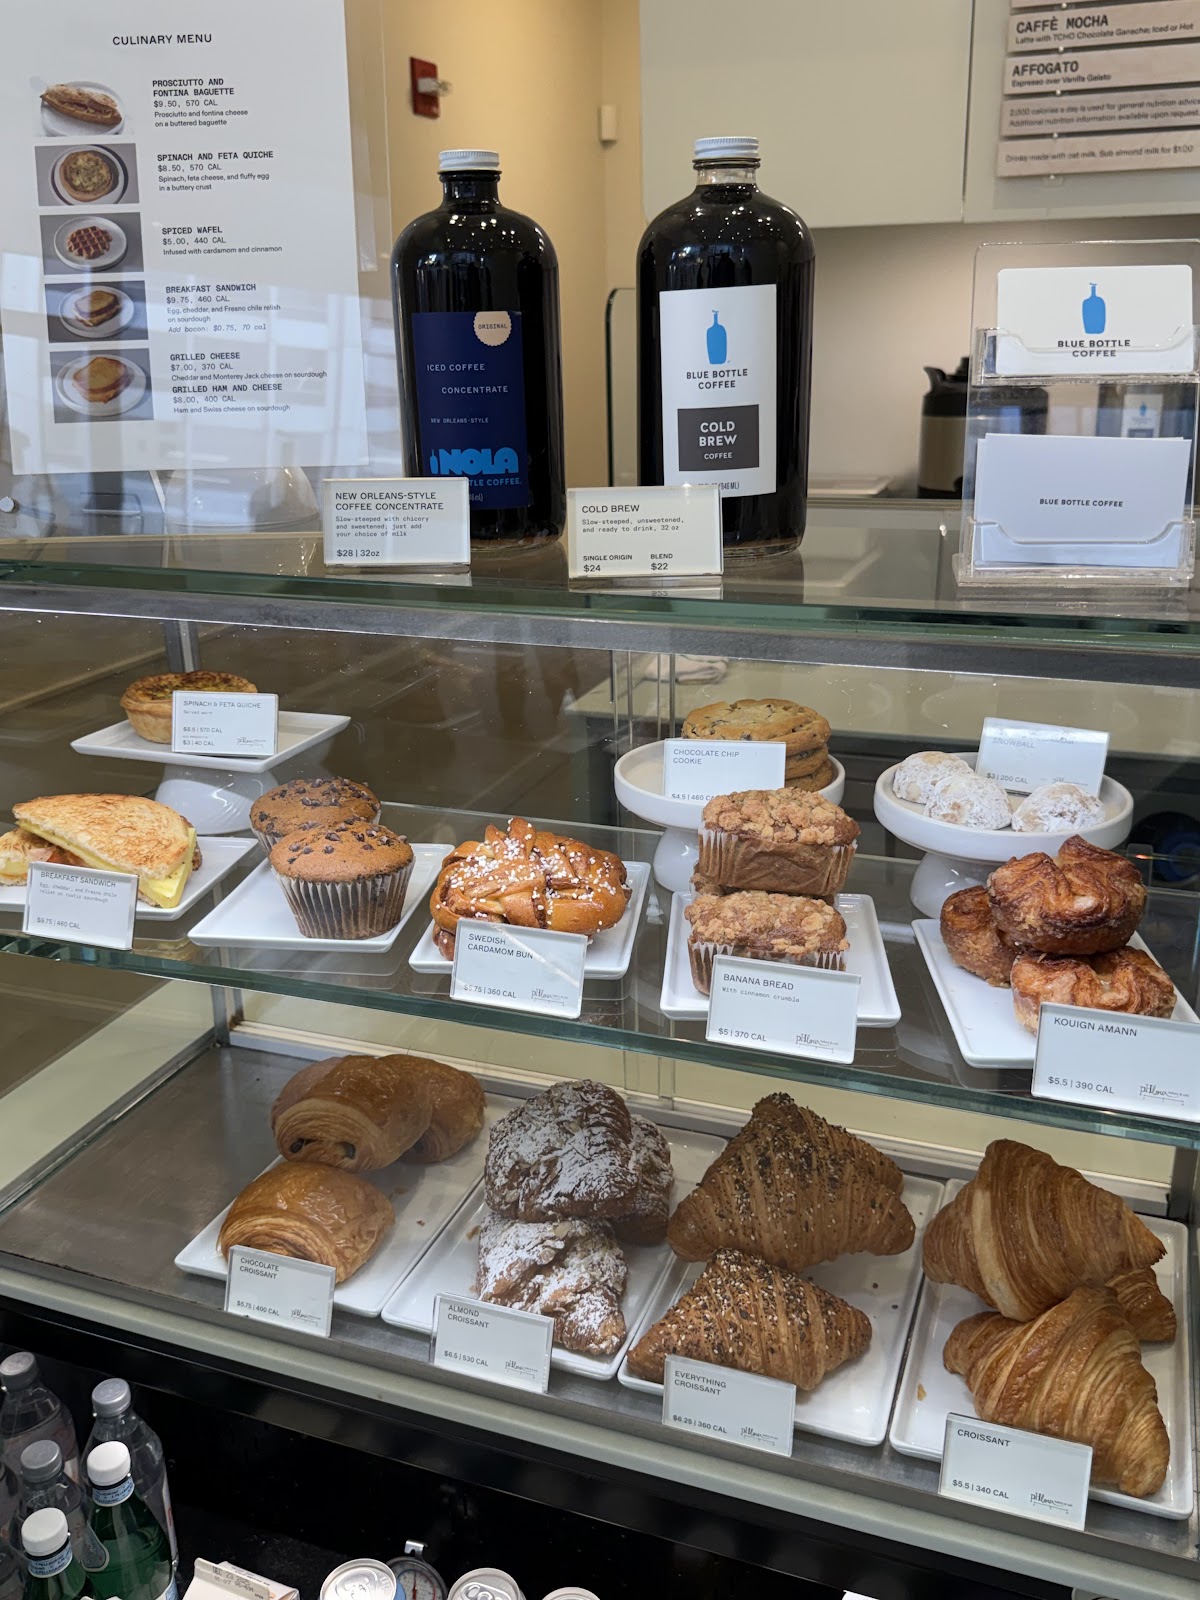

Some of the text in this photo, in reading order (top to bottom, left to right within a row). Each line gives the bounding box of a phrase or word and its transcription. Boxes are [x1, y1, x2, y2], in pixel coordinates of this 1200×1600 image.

[1017, 15, 1108, 33] CAFFÈ MOCHA
[113, 34, 212, 45] CULINARY MENU
[1012, 61, 1079, 77] AFFOGATO
[152, 79, 203, 87] PROSCIUTTO
[153, 89, 188, 97] FONTINA
[154, 100, 180, 108] $9.50,
[243, 151, 273, 159] QUICHE
[159, 175, 186, 183] Spinach,
[166, 284, 256, 293] BREAKFAST SANDWICH
[210, 352, 240, 360] CHEESE
[1072, 350, 1116, 358] COFFEE
[687, 369, 748, 379] BLUE BOTTLE
[698, 380, 736, 389] COFFEE
[442, 386, 508, 394] CONCENTRATE
[701, 421, 735, 433] COLD
[699, 435, 737, 446] BREW
[439, 447, 519, 475] NOLA
[704, 452, 732, 460] COFFEE
[469, 478, 484, 486] TLE
[336, 503, 372, 511] COFFEE
[992, 738, 1035, 748] SNOWBALL
[41, 872, 116, 888] BREAKFAST SANDWICH
[469, 934, 506, 945] SWEDISH
[468, 944, 533, 959] CARDAMOM BUN
[724, 974, 794, 990] BANANA BREAD
[740, 989, 769, 998] cinnamon
[773, 994, 800, 1003] crumble
[1054, 1017, 1137, 1036] KOUIGN AMANN
[751, 1033, 766, 1042] CAL
[1096, 1085, 1114, 1094] CAL
[241, 1258, 279, 1271] CHOCOLATE
[240, 1266, 277, 1279] CROISSANT
[449, 1305, 479, 1317] ALMOND
[448, 1314, 489, 1328] CROISSANT
[476, 1358, 488, 1366] CAL
[675, 1370, 726, 1388] EVERYTHING
[675, 1380, 721, 1395] CROISSANT
[957, 1429, 1010, 1446] CROISSANT
[993, 1489, 1009, 1499] CAL
